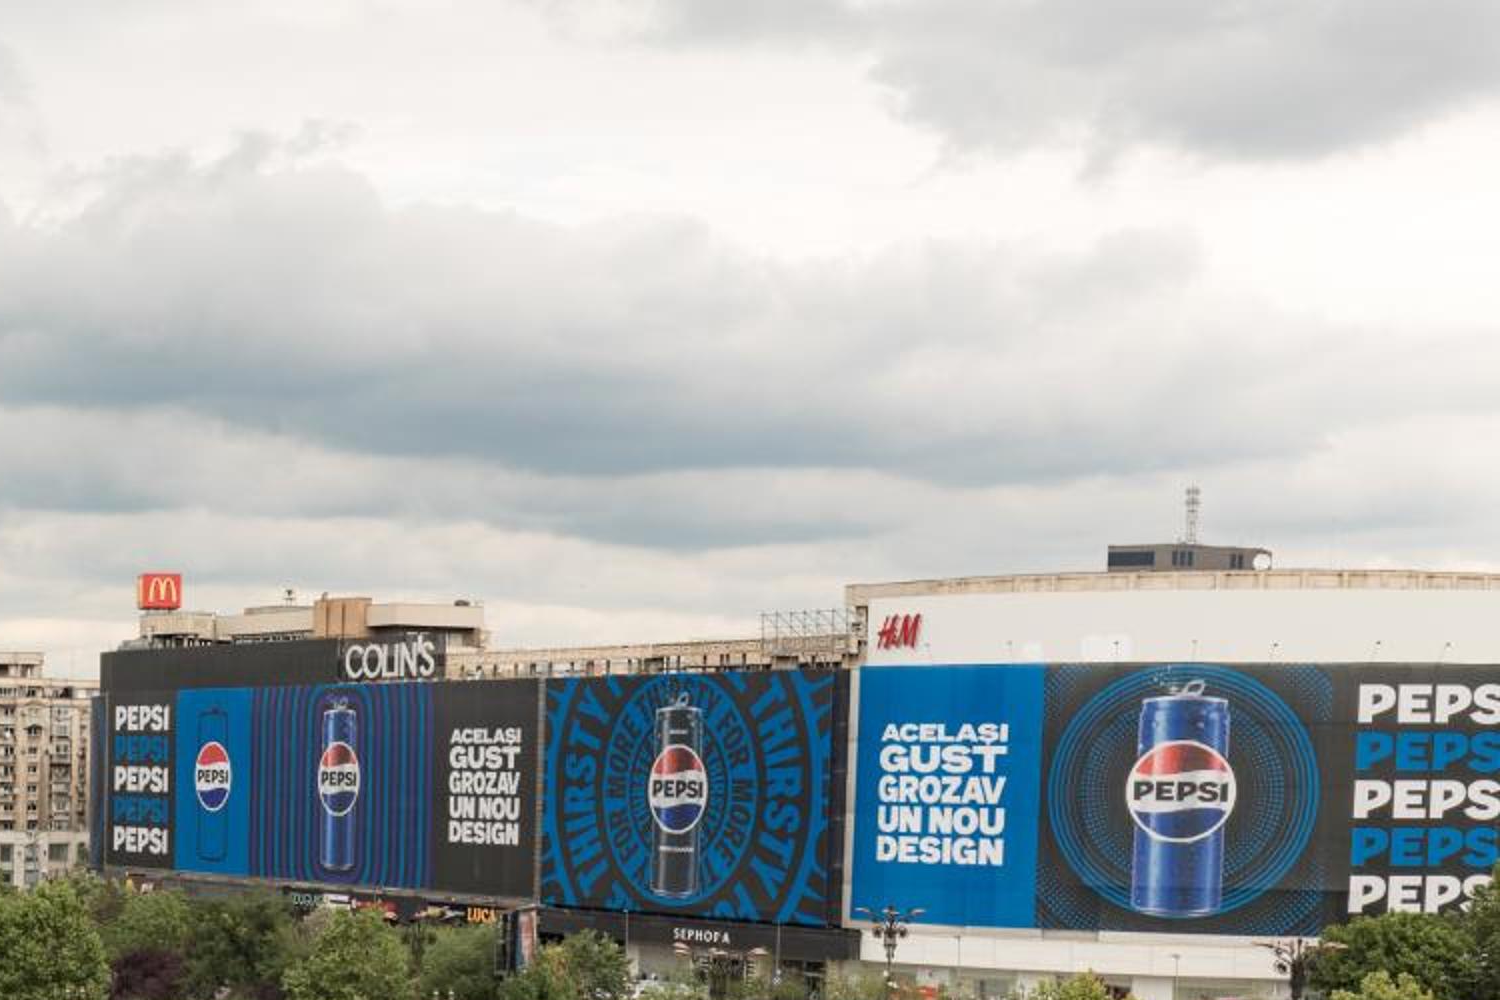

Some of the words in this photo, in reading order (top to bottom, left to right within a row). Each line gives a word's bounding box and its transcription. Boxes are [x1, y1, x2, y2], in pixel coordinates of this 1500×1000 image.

[878, 614, 922, 649] H&M
[345, 635, 435, 680] COLIN'S
[115, 705, 169, 731] PEPSI
[115, 736, 168, 763] PEPSI
[449, 745, 521, 769] GUST
[879, 744, 1008, 774] GUST
[113, 766, 168, 793] PEPSI
[197, 769, 230, 784] PEPSI
[321, 771, 358, 788] PEPSI
[448, 771, 521, 795] GROZAV
[564, 684, 610, 894] THIRSTY
[652, 780, 703, 799] PEPSI
[749, 676, 800, 901] THIRSTY
[878, 775, 1006, 805] GROZAV
[1133, 780, 1230, 804] PEPSI
[113, 798, 168, 824] PEPSI
[449, 796, 476, 819] UN
[478, 797, 521, 821] NOU
[877, 805, 922, 833] UN
[929, 807, 1006, 836] NOU
[112, 825, 169, 855] PEPSI
[448, 821, 520, 846] DESIGN
[876, 835, 1004, 866] DESIGN
[467, 906, 496, 923] LUCA
